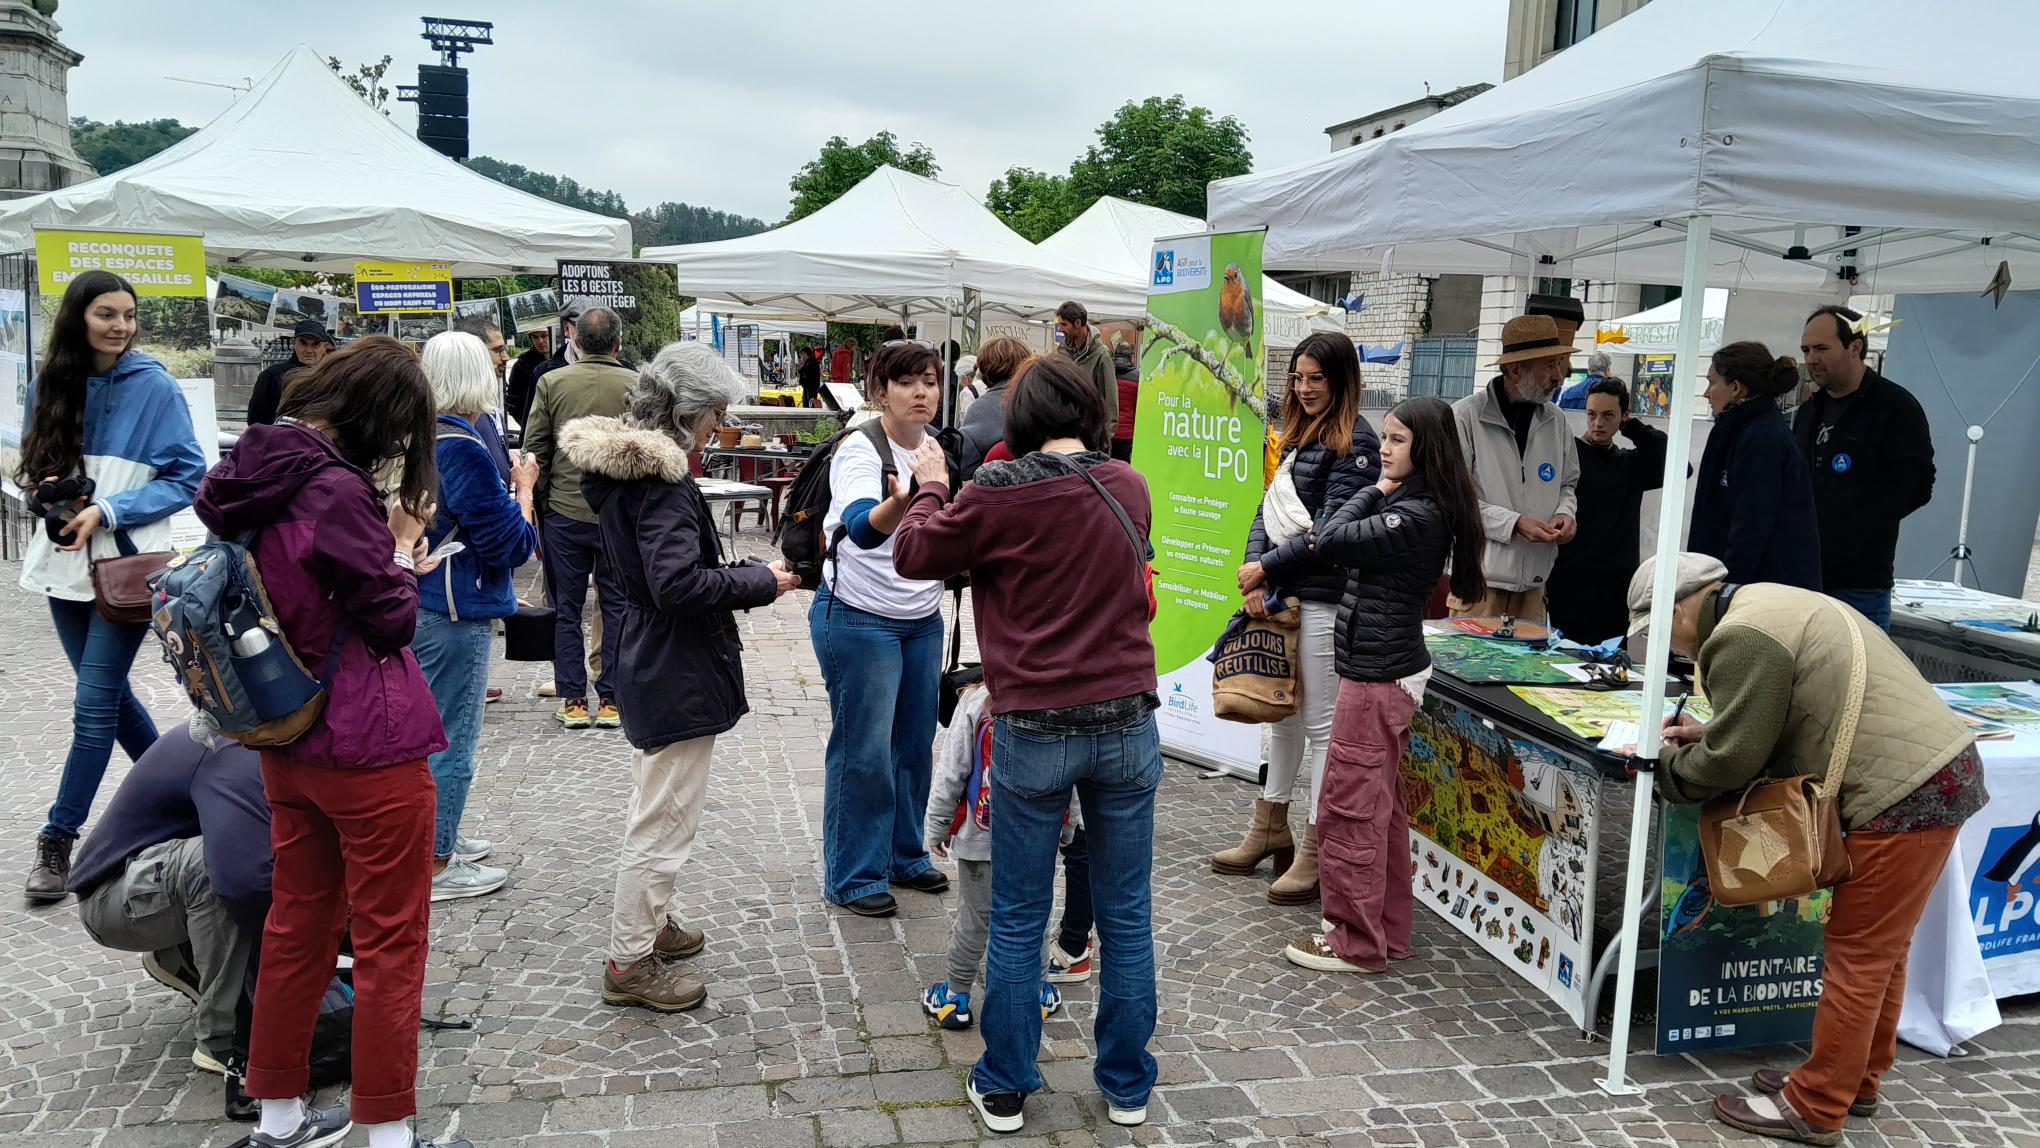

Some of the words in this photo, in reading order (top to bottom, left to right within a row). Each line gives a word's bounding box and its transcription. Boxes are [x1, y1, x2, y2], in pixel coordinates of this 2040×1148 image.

[68, 242, 174, 256] RECONQUETE
[70, 257, 101, 269] DES
[105, 258, 175, 270] ESPACES
[561, 264, 610, 279] ADOPTONS
[562, 279, 580, 293] LES
[580, 280, 588, 293] 8
[589, 280, 624, 294] GESTES
[1156, 276, 1171, 284] LPO
[1158, 391, 1180, 408] Pour
[1182, 393, 1192, 409] la
[1163, 406, 1242, 444] nature
[1167, 444, 1190, 458] avec
[1193, 443, 1202, 459] la
[1204, 444, 1248, 483] LPO
[1180, 505, 1197, 516] faune
[1198, 510, 1222, 521] sauvage
[1161, 535, 1195, 549] Développer
[1174, 551, 1198, 562] espaces
[1199, 555, 1225, 567] naturels
[1183, 597, 1209, 610] citoyens
[1223, 632, 1283, 655] OUJOURS
[1167, 695, 1199, 713] BirdLife
[1721, 955, 1818, 979] INVENTAIRE
[1689, 988, 1711, 1007] DE
[1717, 987, 1738, 1004] LA
